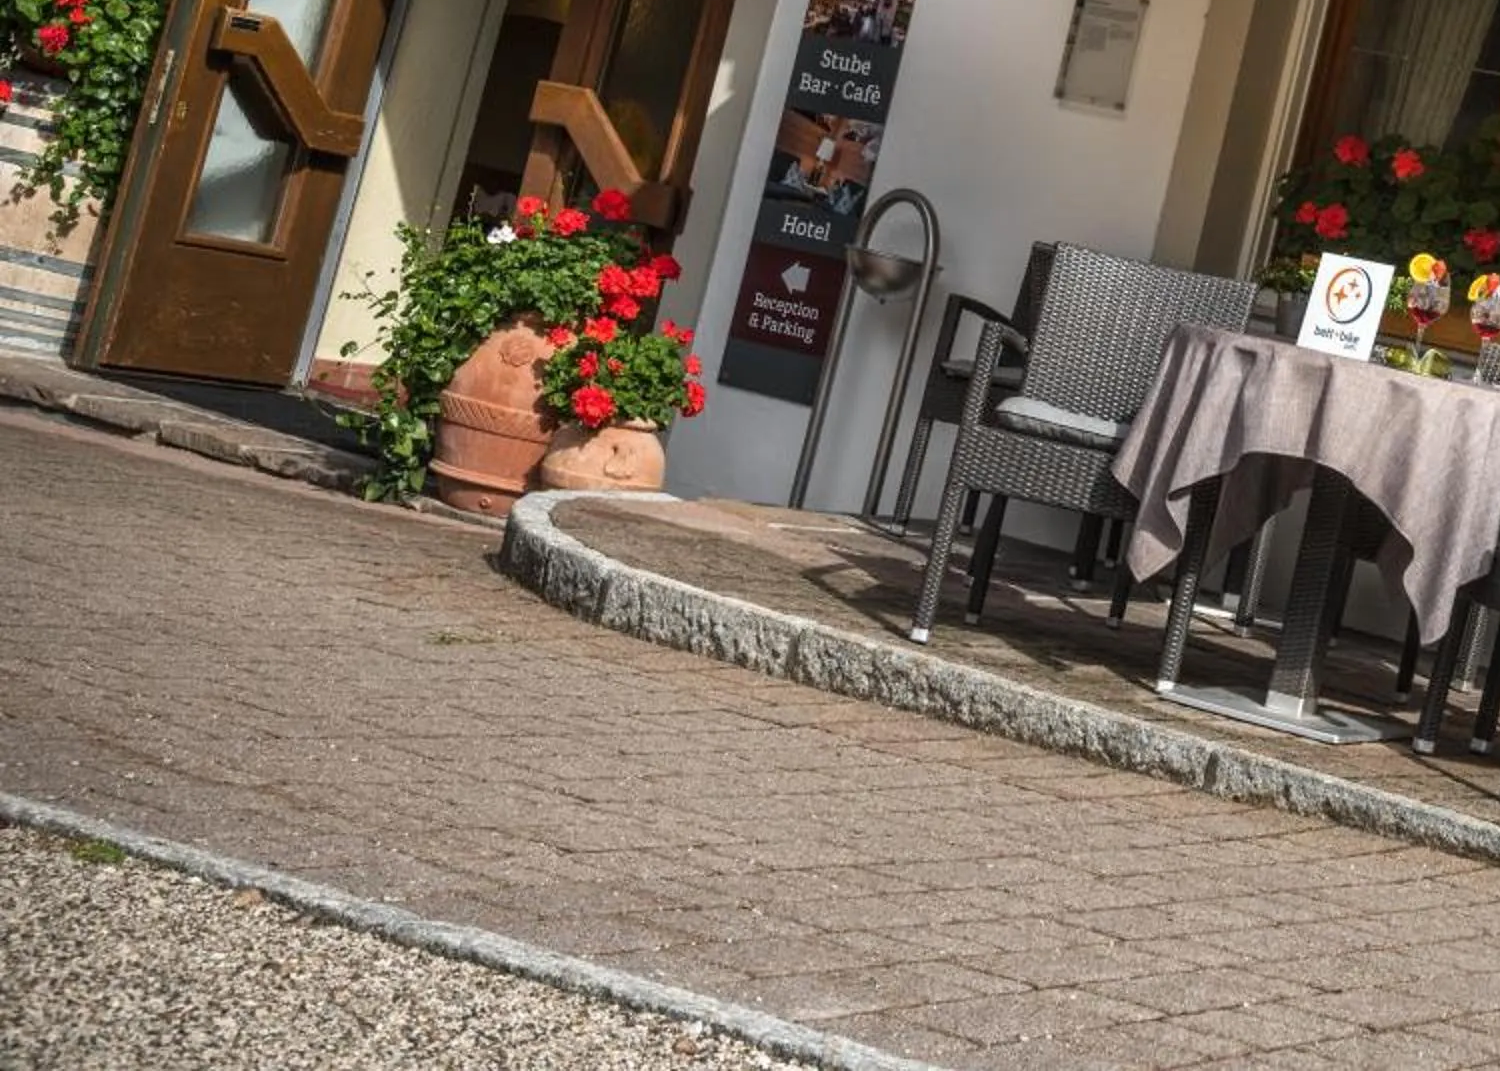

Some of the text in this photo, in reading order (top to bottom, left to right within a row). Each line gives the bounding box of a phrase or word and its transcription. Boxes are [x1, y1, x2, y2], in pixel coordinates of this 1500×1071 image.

[820, 49, 872, 76] Stube
[799, 72, 831, 96] Bar
[781, 213, 831, 242] Hotel
[753, 292, 819, 321] Reception
[748, 312, 816, 344] & Parking
